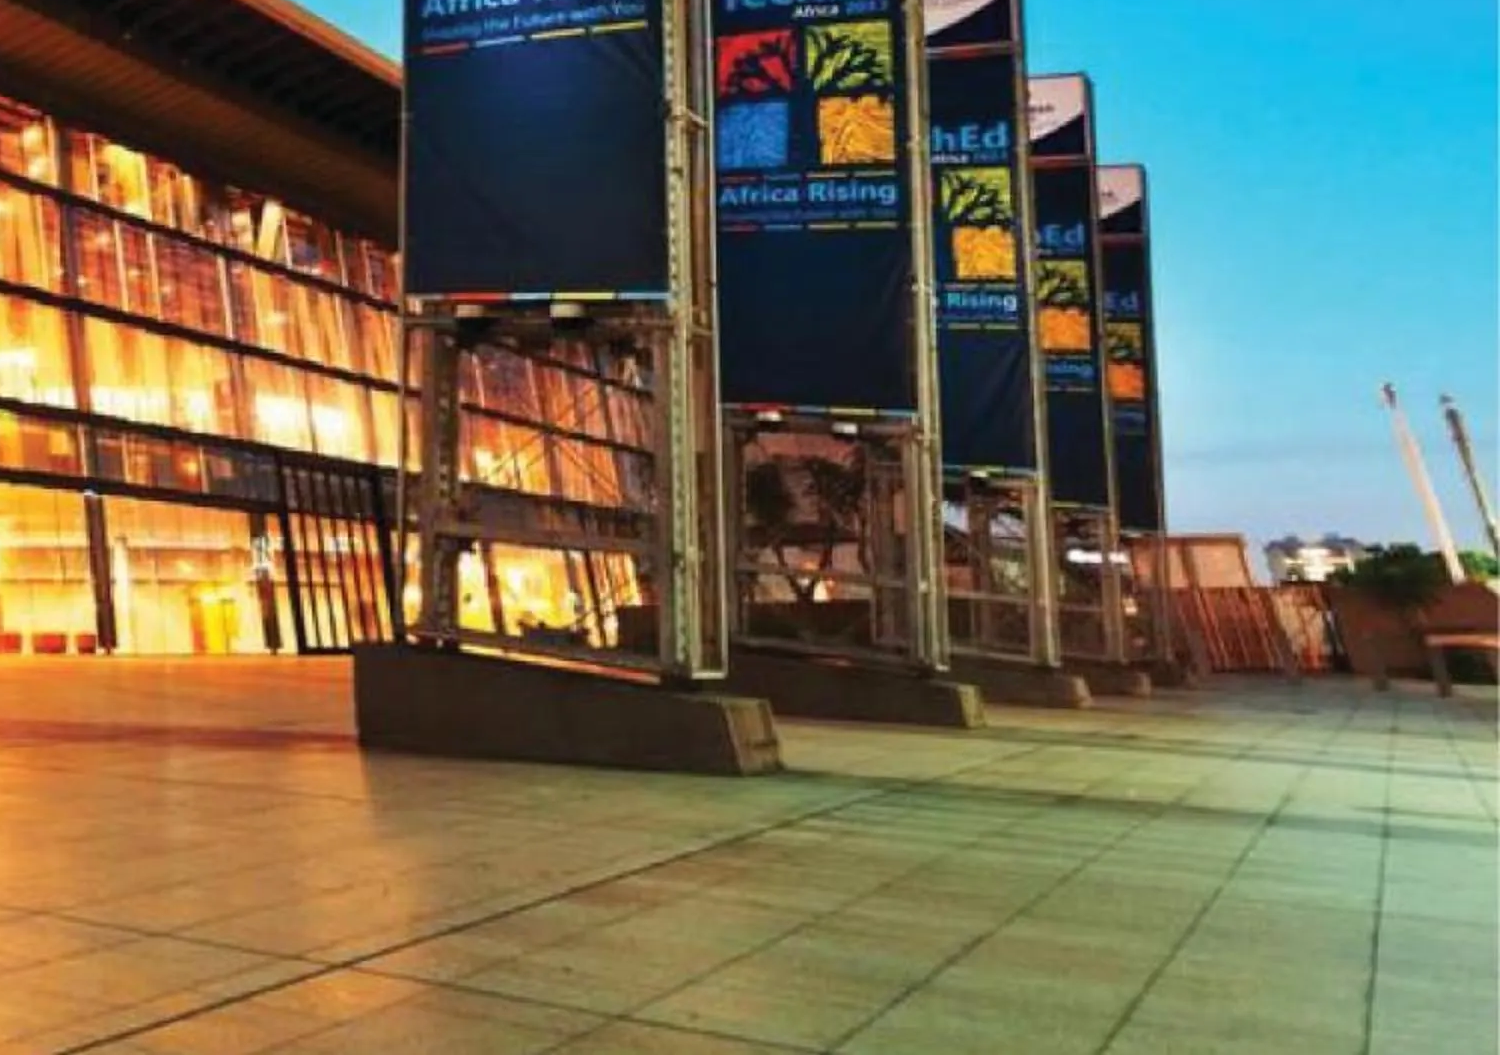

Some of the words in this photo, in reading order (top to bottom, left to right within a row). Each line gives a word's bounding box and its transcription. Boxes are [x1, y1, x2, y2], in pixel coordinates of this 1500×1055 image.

[931, 121, 1007, 152] hEd
[720, 183, 798, 205] Africa
[806, 181, 897, 205] Rising
